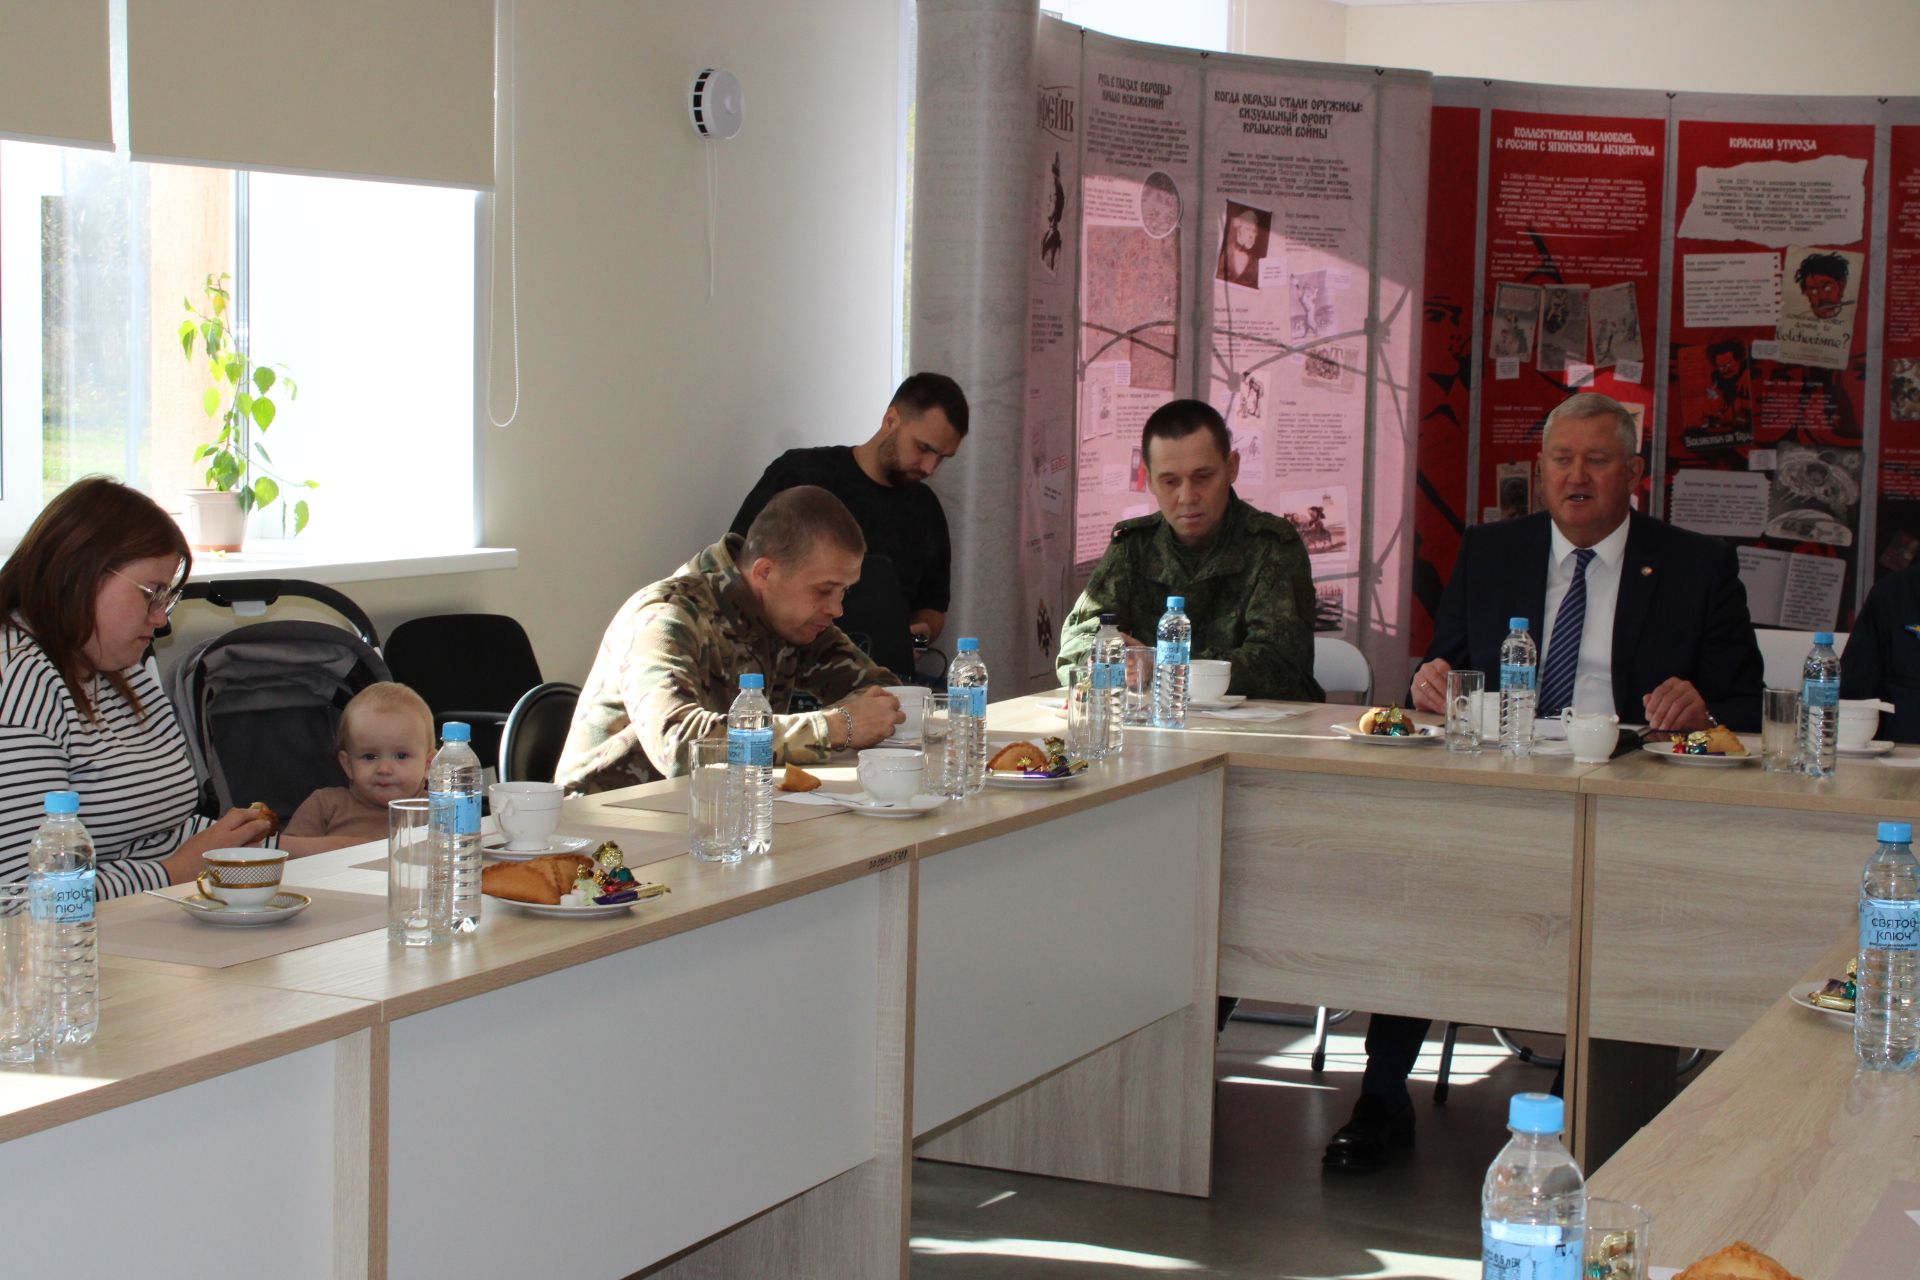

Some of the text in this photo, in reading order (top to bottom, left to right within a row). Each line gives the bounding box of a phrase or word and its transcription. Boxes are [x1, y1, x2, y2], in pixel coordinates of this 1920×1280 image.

[1214, 90, 1363, 113] КОГДА ОБРАЗЫ СТАЛИ ОРУЖИЕМ:
[1239, 107, 1334, 126] ВИЗУАЛЬНЫЙ ФРОНТ
[1242, 122, 1328, 139] КРЫМСКОЙ ВОЙНЫ
[1513, 127, 1636, 144] КОЛЛЕКТИВНАЯ НЕЛЮБОВЬ
[1496, 138, 1656, 158] К РОССИИ С ЯПОНСКИМ АКЦЕНТОМ
[1728, 137, 1818, 152] КРАСНАЯ УГРОЗА
[56, 888, 88, 902] ЯТОЙ
[55, 904, 84, 914] ЛЮЧ
[1871, 917, 1917, 929] СВЯТОЙ
[1876, 930, 1912, 943] КЛЮЧ
